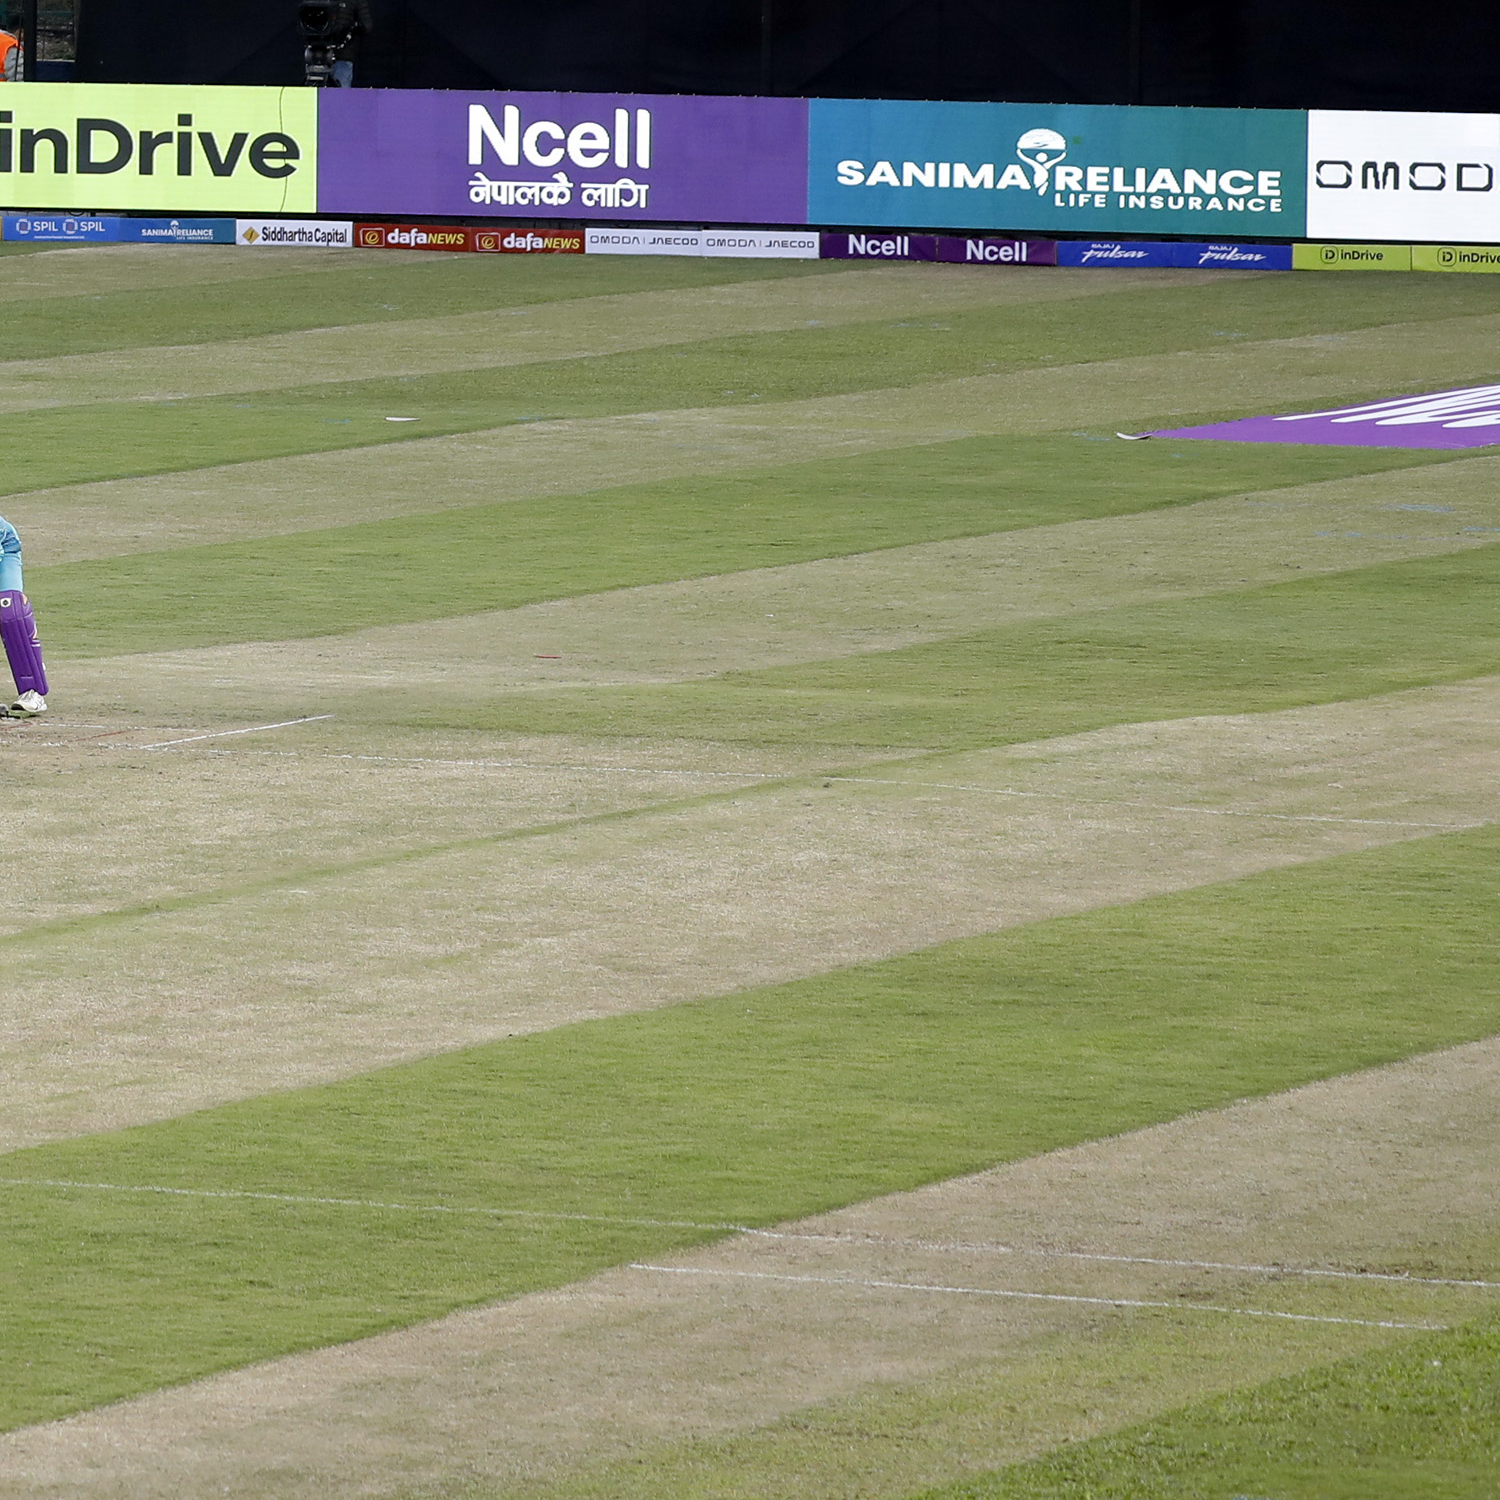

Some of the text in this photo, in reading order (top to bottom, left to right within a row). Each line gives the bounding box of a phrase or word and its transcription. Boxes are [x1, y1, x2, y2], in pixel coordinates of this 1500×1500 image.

[467, 103, 651, 169] Ncell
[836, 159, 1282, 197] SANIMA RELIANCE
[1315, 159, 1500, 193] OMOD
[580, 177, 650, 209] लागि
[1054, 192, 1283, 212] LIFE INSURANCE
[33, 220, 105, 232] SPIL SPIL
[141, 228, 214, 237] SANIMA RELIANCE
[261, 225, 347, 246] Siddhartha Capital
[387, 227, 465, 247] dafaNEWS
[502, 232, 580, 251] dafaNEWS
[589, 234, 699, 246] OMODA JAECOO
[706, 237, 815, 249] OMODA JAECOO
[848, 234, 909, 256] Ncell
[965, 239, 1027, 262] Ncell
[1081, 244, 1149, 263] pulsar
[1198, 246, 1266, 264] pulsar
[1340, 249, 1383, 261] inDrive
